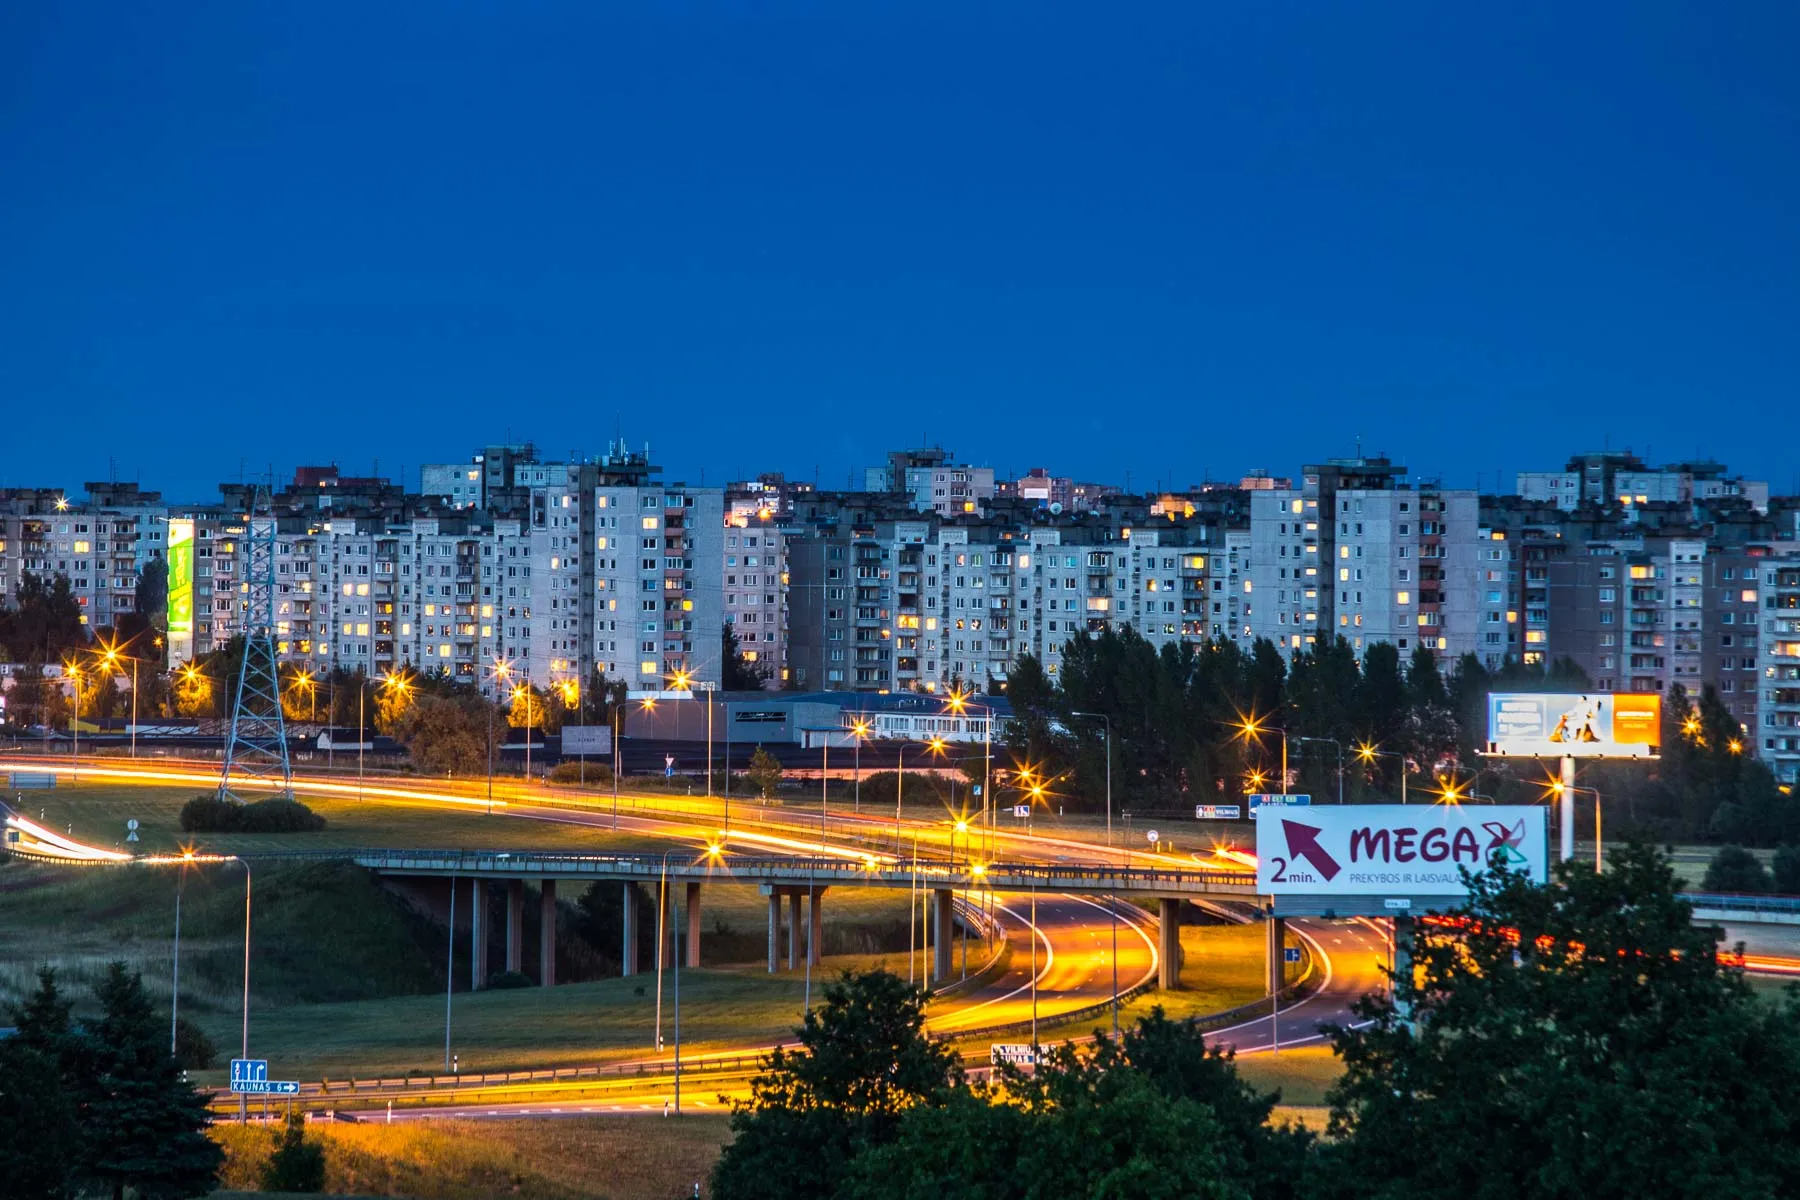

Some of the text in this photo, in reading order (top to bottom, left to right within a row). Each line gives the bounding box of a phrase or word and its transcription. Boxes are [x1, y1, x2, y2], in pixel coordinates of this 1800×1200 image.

[1350, 826, 1480, 864] MEGA
[1270, 857, 1317, 883] 2 min.
[1350, 873, 1461, 884] PREKYBOS IR LAISVALA
[1005, 1045, 1032, 1054] VILNIU
[233, 1081, 282, 1092] KAUNAS 6
